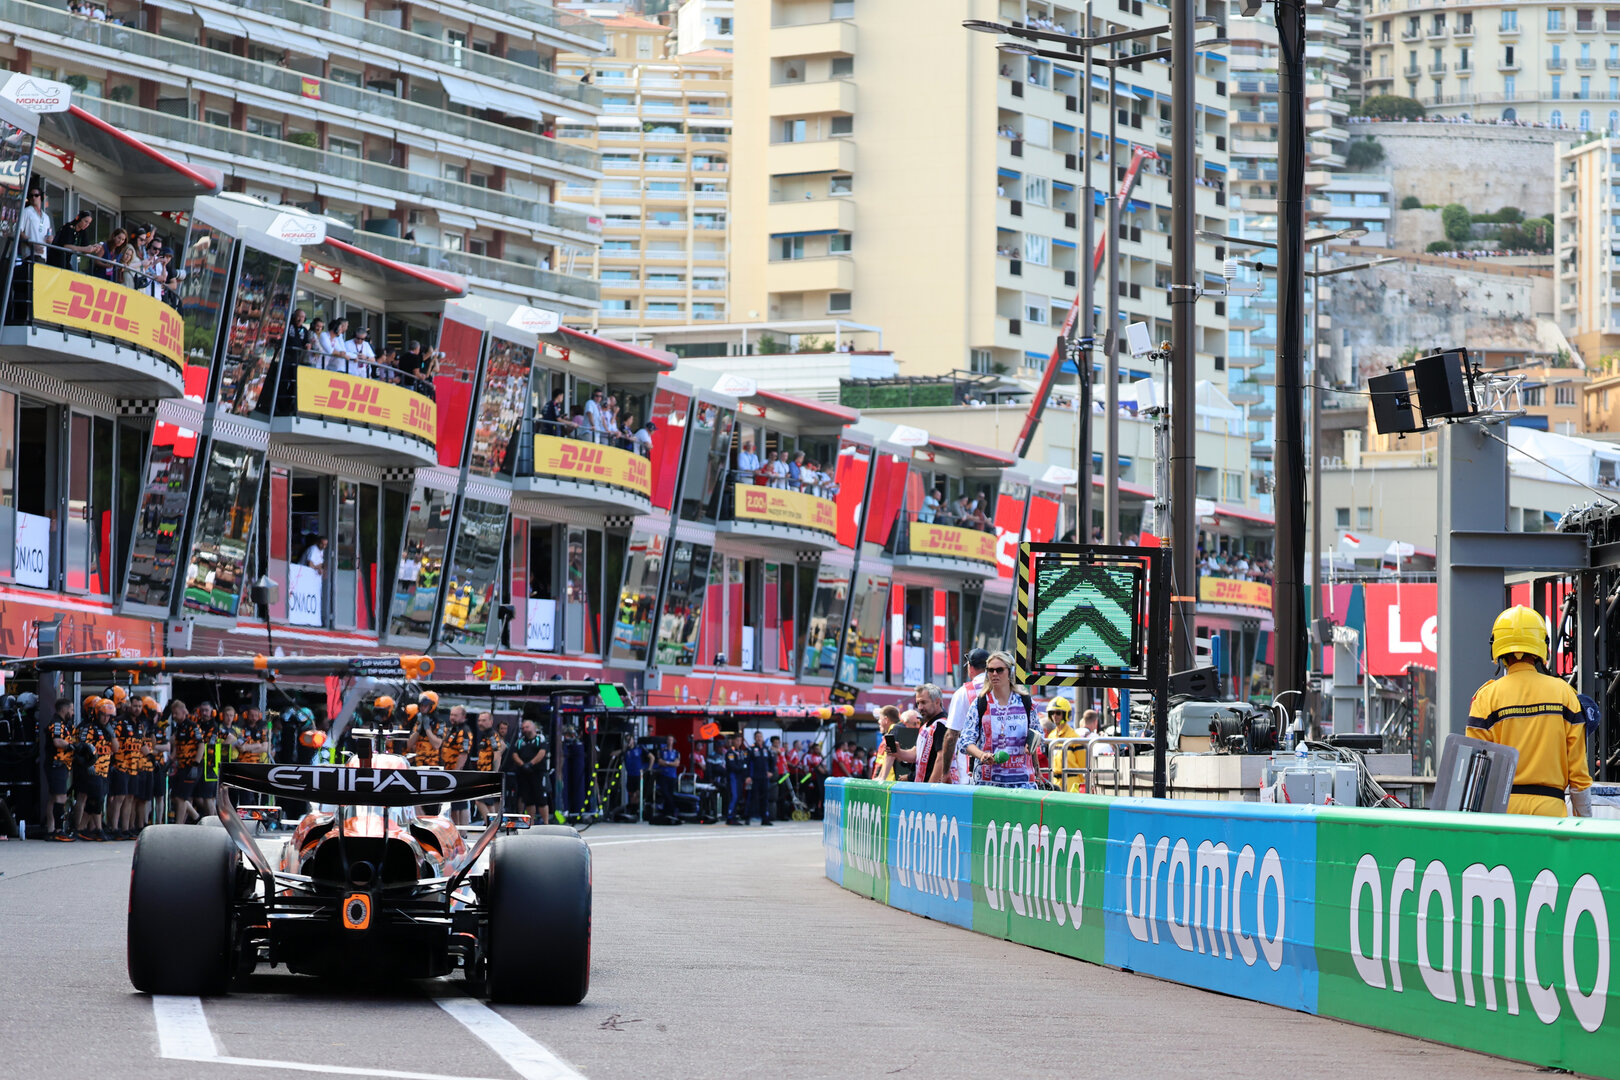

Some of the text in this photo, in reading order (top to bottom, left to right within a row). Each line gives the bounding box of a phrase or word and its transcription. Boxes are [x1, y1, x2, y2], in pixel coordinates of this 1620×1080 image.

[67, 280, 132, 331] DHL
[159, 310, 182, 357] DHL
[327, 378, 383, 417] DHL
[408, 397, 433, 435] DHL
[560, 444, 606, 475] DHL
[628, 457, 649, 488] DHL
[929, 529, 963, 551] DHL
[15, 546, 44, 574] ONACO
[289, 591, 317, 614] ONACO
[1215, 581, 1245, 600] DHL
[1546, 704, 1563, 712] MONAC
[267, 765, 458, 795] ETIHAD
[847, 799, 882, 879] aramco
[897, 809, 960, 902] aramco
[984, 819, 1085, 931] aramco
[1125, 832, 1286, 972] aramco
[1349, 852, 1610, 1033] aramco
